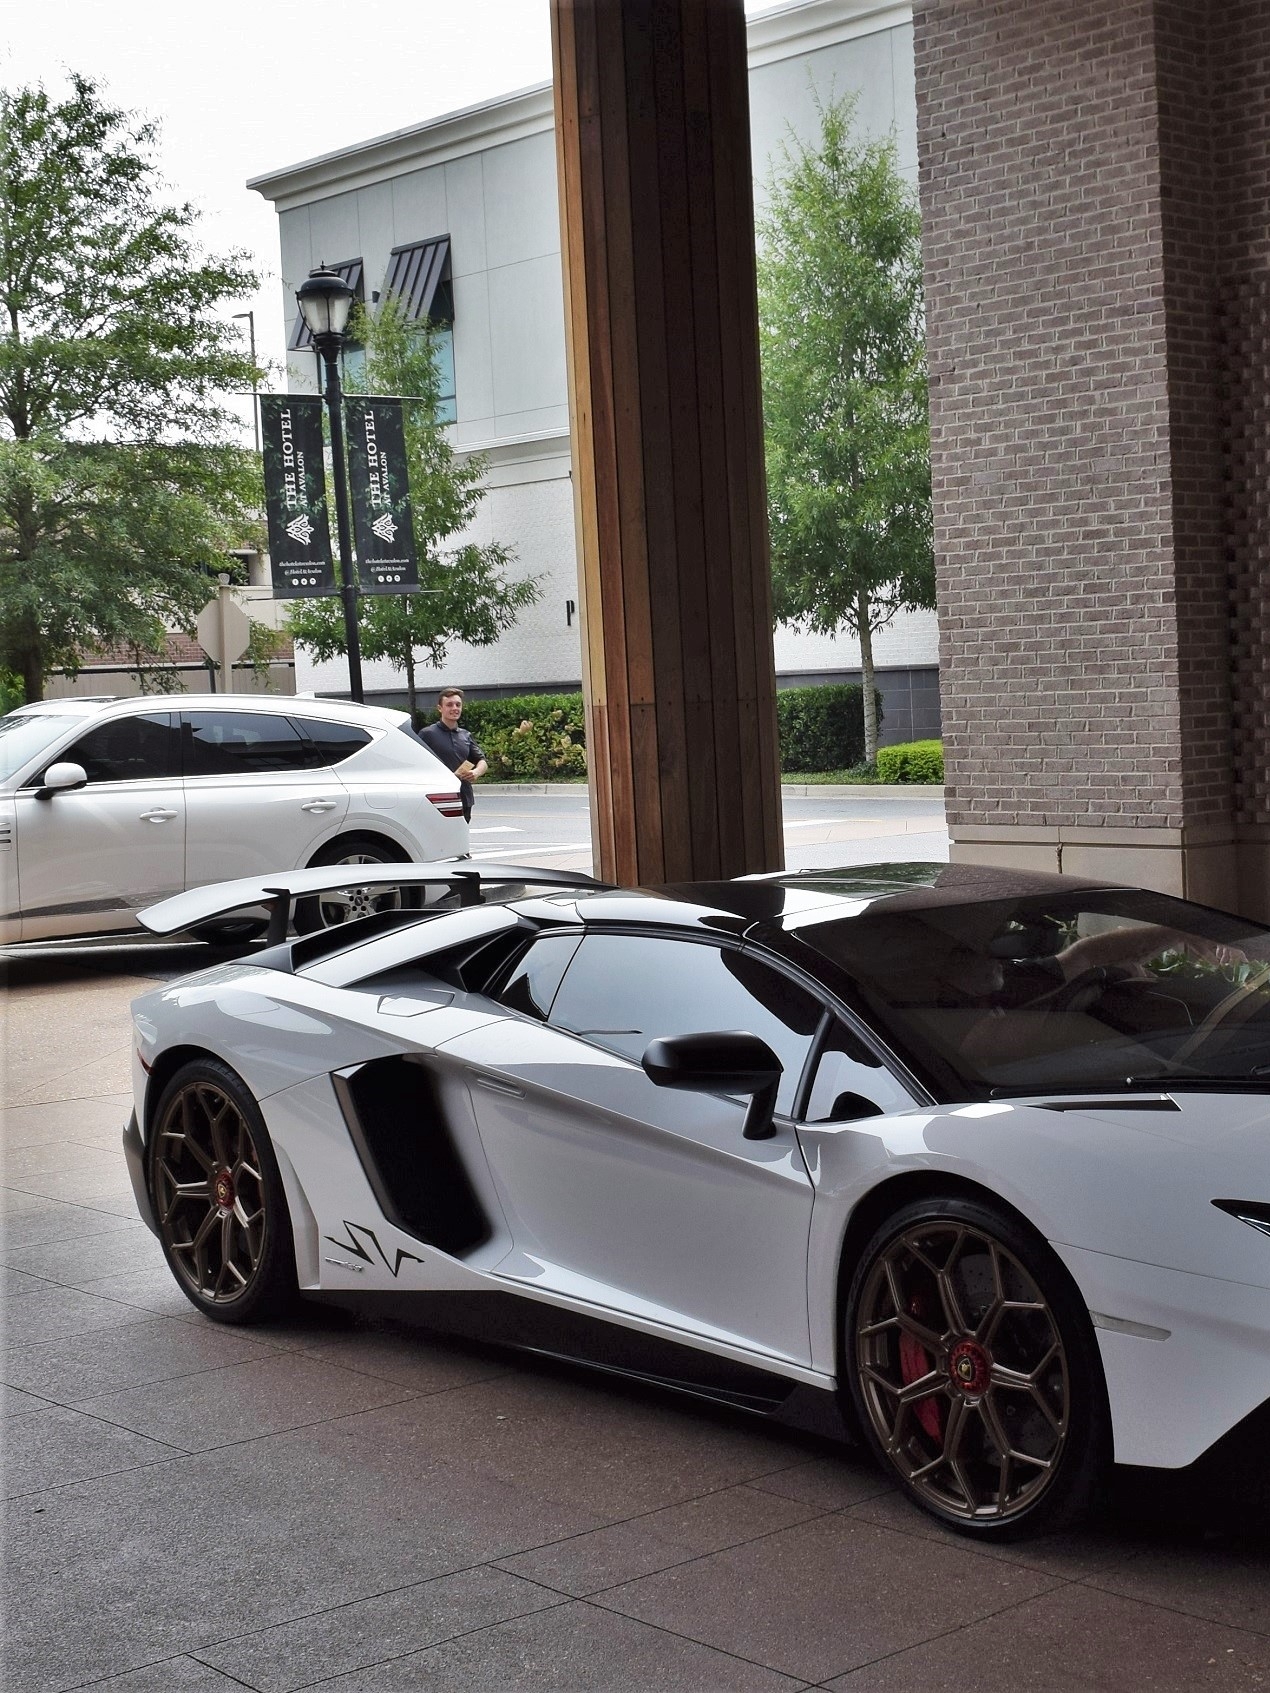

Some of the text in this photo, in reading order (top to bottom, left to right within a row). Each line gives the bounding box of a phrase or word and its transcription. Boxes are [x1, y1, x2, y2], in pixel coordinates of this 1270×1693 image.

[281, 409, 298, 511] THE HOTEL
[296, 451, 307, 492] AVALON
[364, 410, 382, 511] THE HOTEL
[379, 451, 390, 491] AVALON
